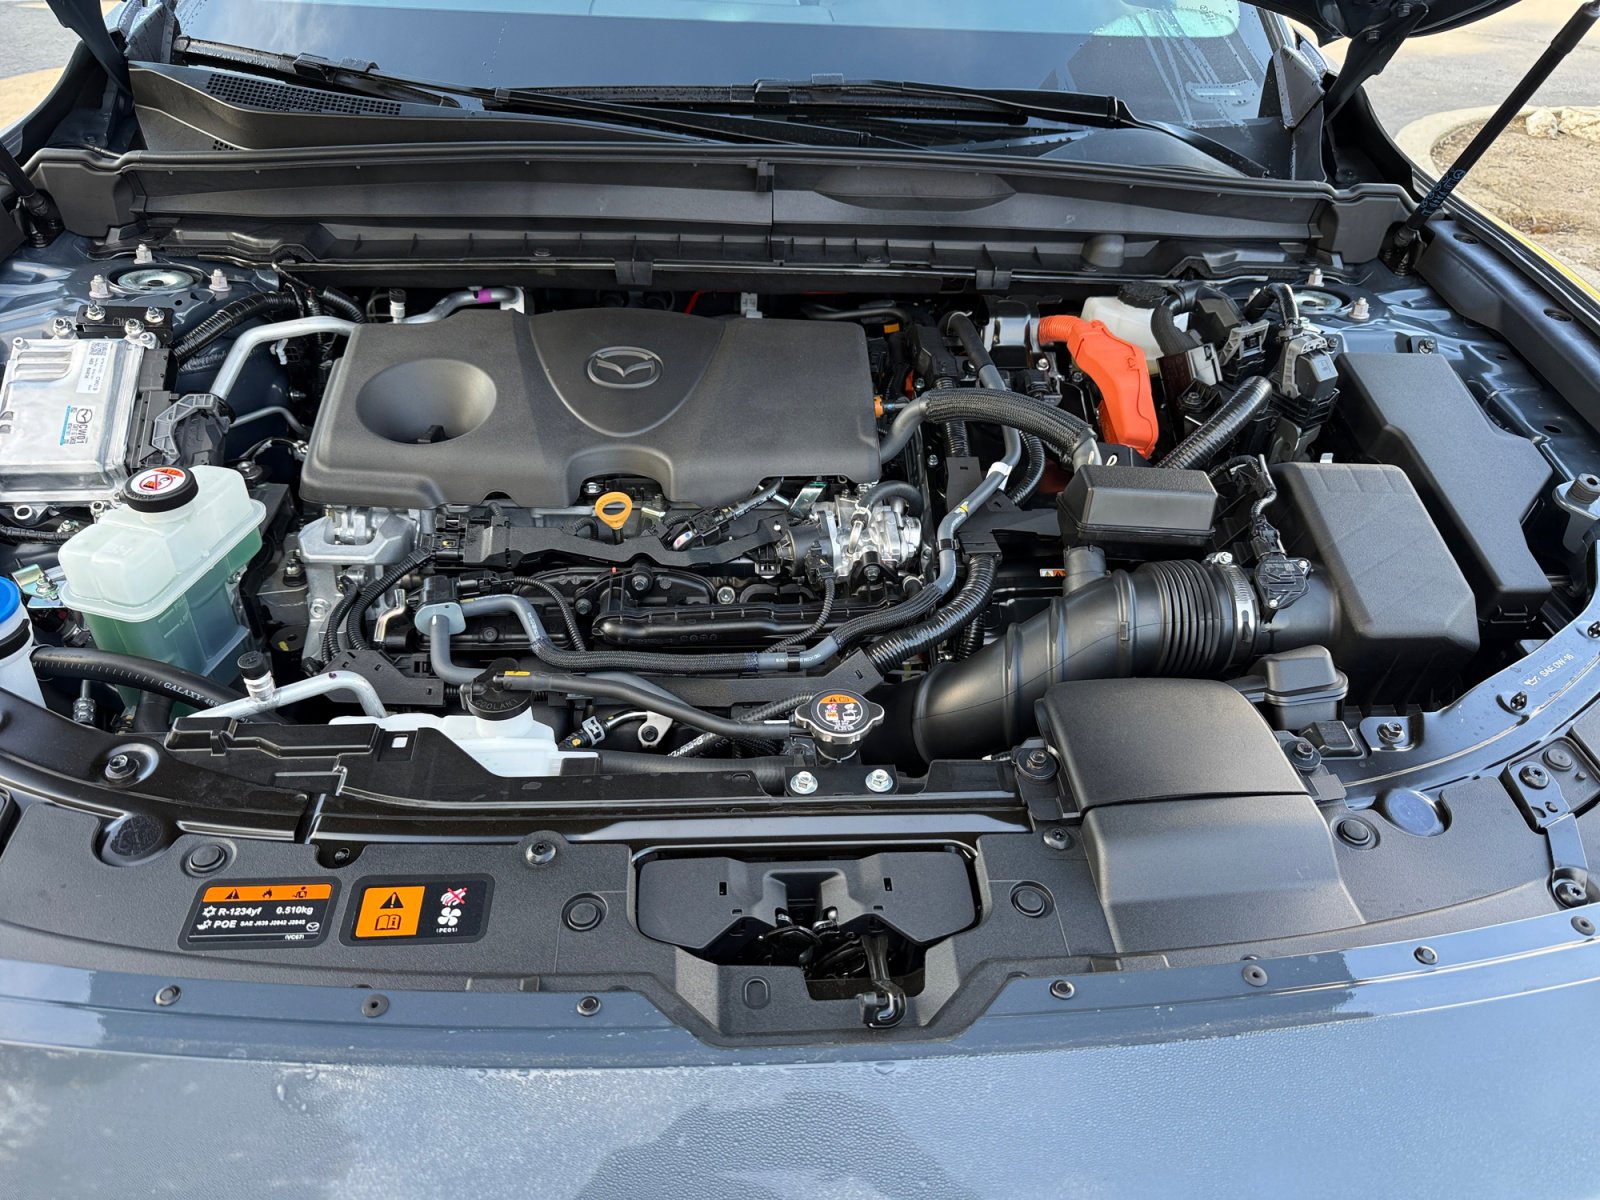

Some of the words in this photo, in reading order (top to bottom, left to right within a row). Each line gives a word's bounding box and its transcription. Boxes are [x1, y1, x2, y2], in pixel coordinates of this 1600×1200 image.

[1539, 665, 1556, 677] SAE
[1552, 653, 1574, 669] 0W-16
[163, 682, 205, 701] GALAXY
[475, 698, 519, 711] COOLANT
[218, 906, 263, 917] R-1234yf
[275, 906, 314, 915] 0.510kg
[213, 920, 238, 929] POE
